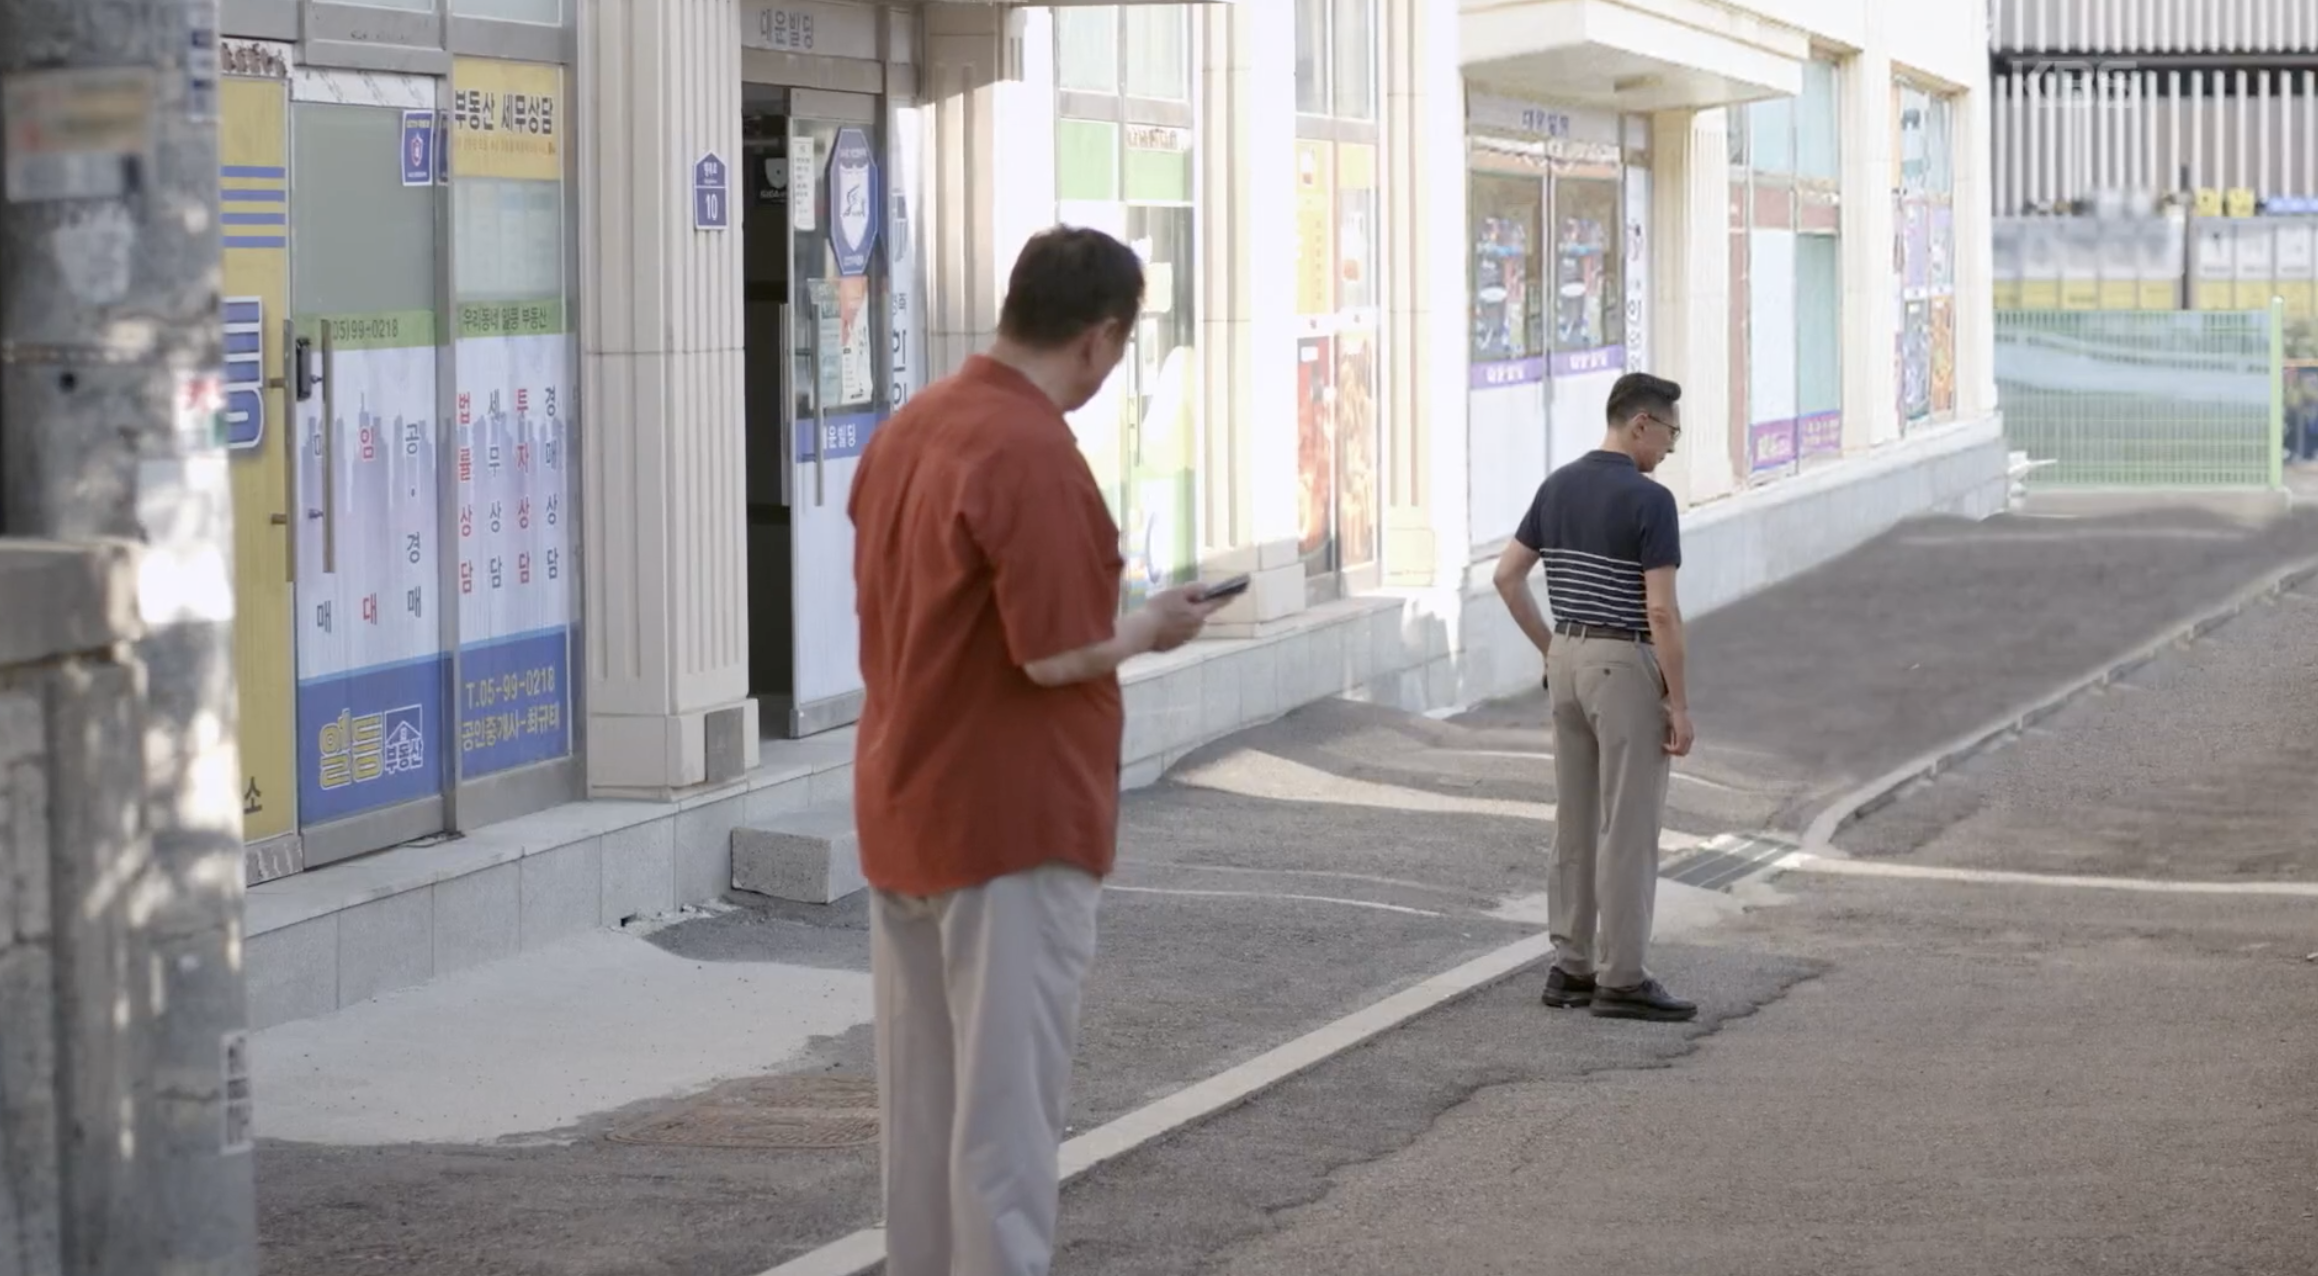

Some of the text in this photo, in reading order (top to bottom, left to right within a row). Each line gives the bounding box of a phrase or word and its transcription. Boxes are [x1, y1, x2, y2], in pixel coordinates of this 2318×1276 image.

[454, 88, 554, 135] 부동산 세무상담
[705, 193, 719, 221] 10
[463, 305, 548, 332] 우리동네 일등 부동산
[824, 423, 856, 450] 운빌딩
[319, 707, 424, 791] 일등 부동산
